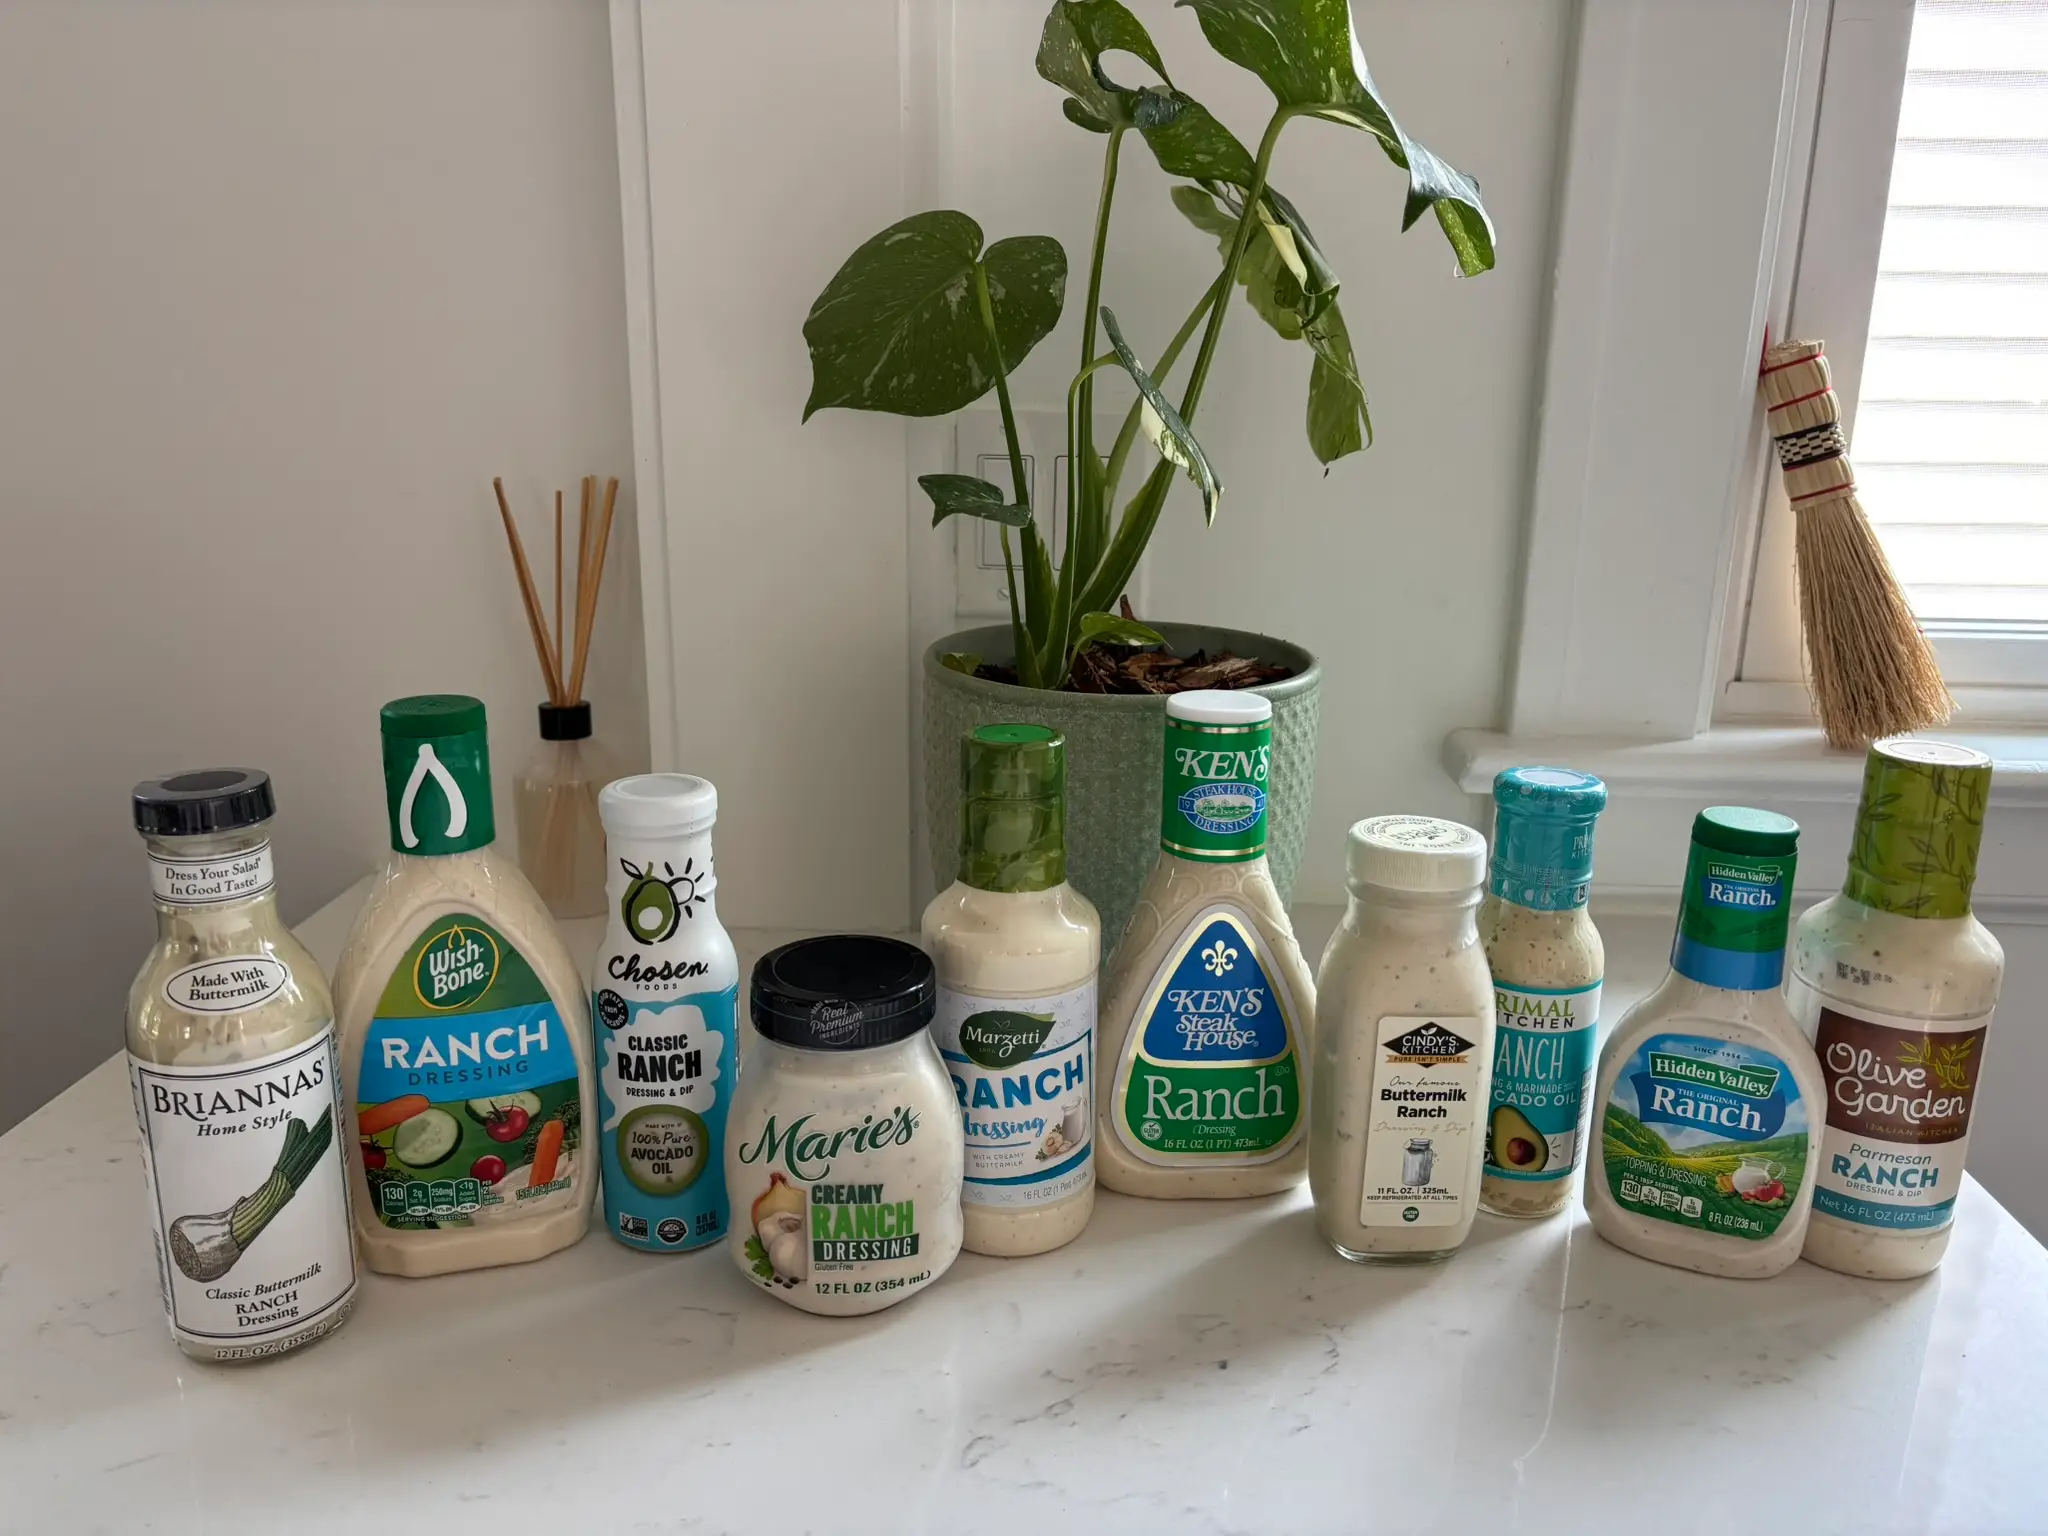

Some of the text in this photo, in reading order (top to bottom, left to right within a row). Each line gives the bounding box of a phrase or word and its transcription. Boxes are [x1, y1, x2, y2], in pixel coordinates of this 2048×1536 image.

[1175, 745, 1270, 781] KEN'S
[1192, 785, 1257, 800] STEAK HOUSE
[1195, 815, 1255, 831] DRESSING
[165, 858, 260, 882] Dress Your Salad
[1711, 865, 1776, 885] Hidden Valley
[170, 875, 259, 897] In Good Taste!
[1709, 881, 1772, 906] Ranch
[190, 966, 265, 988] Made With
[608, 953, 708, 982] Chosen
[189, 979, 270, 1001] Buttermilk
[433, 961, 487, 1000] Bone
[636, 982, 678, 991] FOODS
[821, 1002, 848, 1021] Real
[1167, 987, 1265, 1016] KEN'S
[1495, 991, 1574, 1018] RIMAL
[810, 1011, 864, 1035] Premium
[1176, 1012, 1240, 1034] Steak
[1496, 1010, 1575, 1030] ITCHEN
[381, 1019, 548, 1069] RANCH
[627, 1033, 689, 1052] CLASSIC
[965, 1025, 1040, 1058] Marzetti
[1182, 1028, 1257, 1051] House
[1401, 1046, 1456, 1055] KITCHEN
[1402, 1035, 1457, 1047] CINDY'S
[1496, 1032, 1565, 1081] ANCH
[1693, 1045, 1741, 1060] SINCE 1954
[408, 1060, 529, 1087] DRESSING
[617, 1049, 702, 1083] RANCH
[1826, 1042, 1926, 1089] Olive
[151, 1060, 325, 1121] BRIANNAS
[1515, 1081, 1562, 1094] MARINADE
[1655, 1057, 1772, 1102] Hidden Valley
[626, 1084, 694, 1098] DRESSING & DIP
[1142, 1068, 1287, 1121] Ranch
[1380, 1089, 1467, 1102] Buttermilk
[1493, 1090, 1578, 1107] CADO OIL
[1676, 1087, 1740, 1107] THE ORIGINAL
[1834, 1076, 1966, 1124] Garden
[1396, 1105, 1447, 1118] Ranch
[1650, 1083, 1762, 1132] Ranch
[197, 1108, 293, 1137] Home Style
[1194, 1124, 1238, 1137] Dressing
[632, 1131, 661, 1145] 100%
[739, 1105, 922, 1182] Marie's
[1164, 1139, 1174, 1148] 16
[1176, 1139, 1188, 1148] FL
[1190, 1140, 1204, 1149] OZ
[1206, 1139, 1214, 1149] (1
[1216, 1140, 1232, 1149] PT)
[631, 1145, 694, 1161] AVOCADO
[994, 1152, 1025, 1160] CREAMY
[1849, 1143, 1932, 1165] Parmesan
[652, 1162, 673, 1175] OIL
[975, 1160, 1024, 1169] BUTTERMILK
[1625, 1156, 1708, 1187] TOPPING & DRESSING
[1831, 1153, 1939, 1188] RANCH
[384, 1187, 404, 1200] 130
[412, 1189, 423, 1199] 2g
[459, 1181, 474, 1191] <1g
[811, 1183, 885, 1205] CREAMY
[1377, 1187, 1385, 1195] 11
[1400, 1187, 1415, 1195] OZ.
[1421, 1187, 1449, 1195] 325mL
[1623, 1181, 1640, 1195] 130
[1846, 1180, 1923, 1198] DRESSING & DIP
[427, 1214, 468, 1222] SUGGESTION
[811, 1200, 914, 1240] RANCH
[1708, 1211, 1714, 1222] 8
[1714, 1212, 1723, 1225] FL
[1723, 1214, 1734, 1227] OZ
[1734, 1215, 1750, 1230] (236
[1820, 1195, 1935, 1224] Net 16 FL OZ (473 mL)
[823, 1237, 911, 1261] DRESSING
[814, 1263, 854, 1271] Gluten Free
[205, 1262, 323, 1302] Classic Buttermilk
[815, 1270, 931, 1294] 12 FL OZ (354 mL)
[236, 1290, 299, 1316] RANCH
[238, 1305, 300, 1328] Dressing
[216, 1350, 230, 1360] 12
